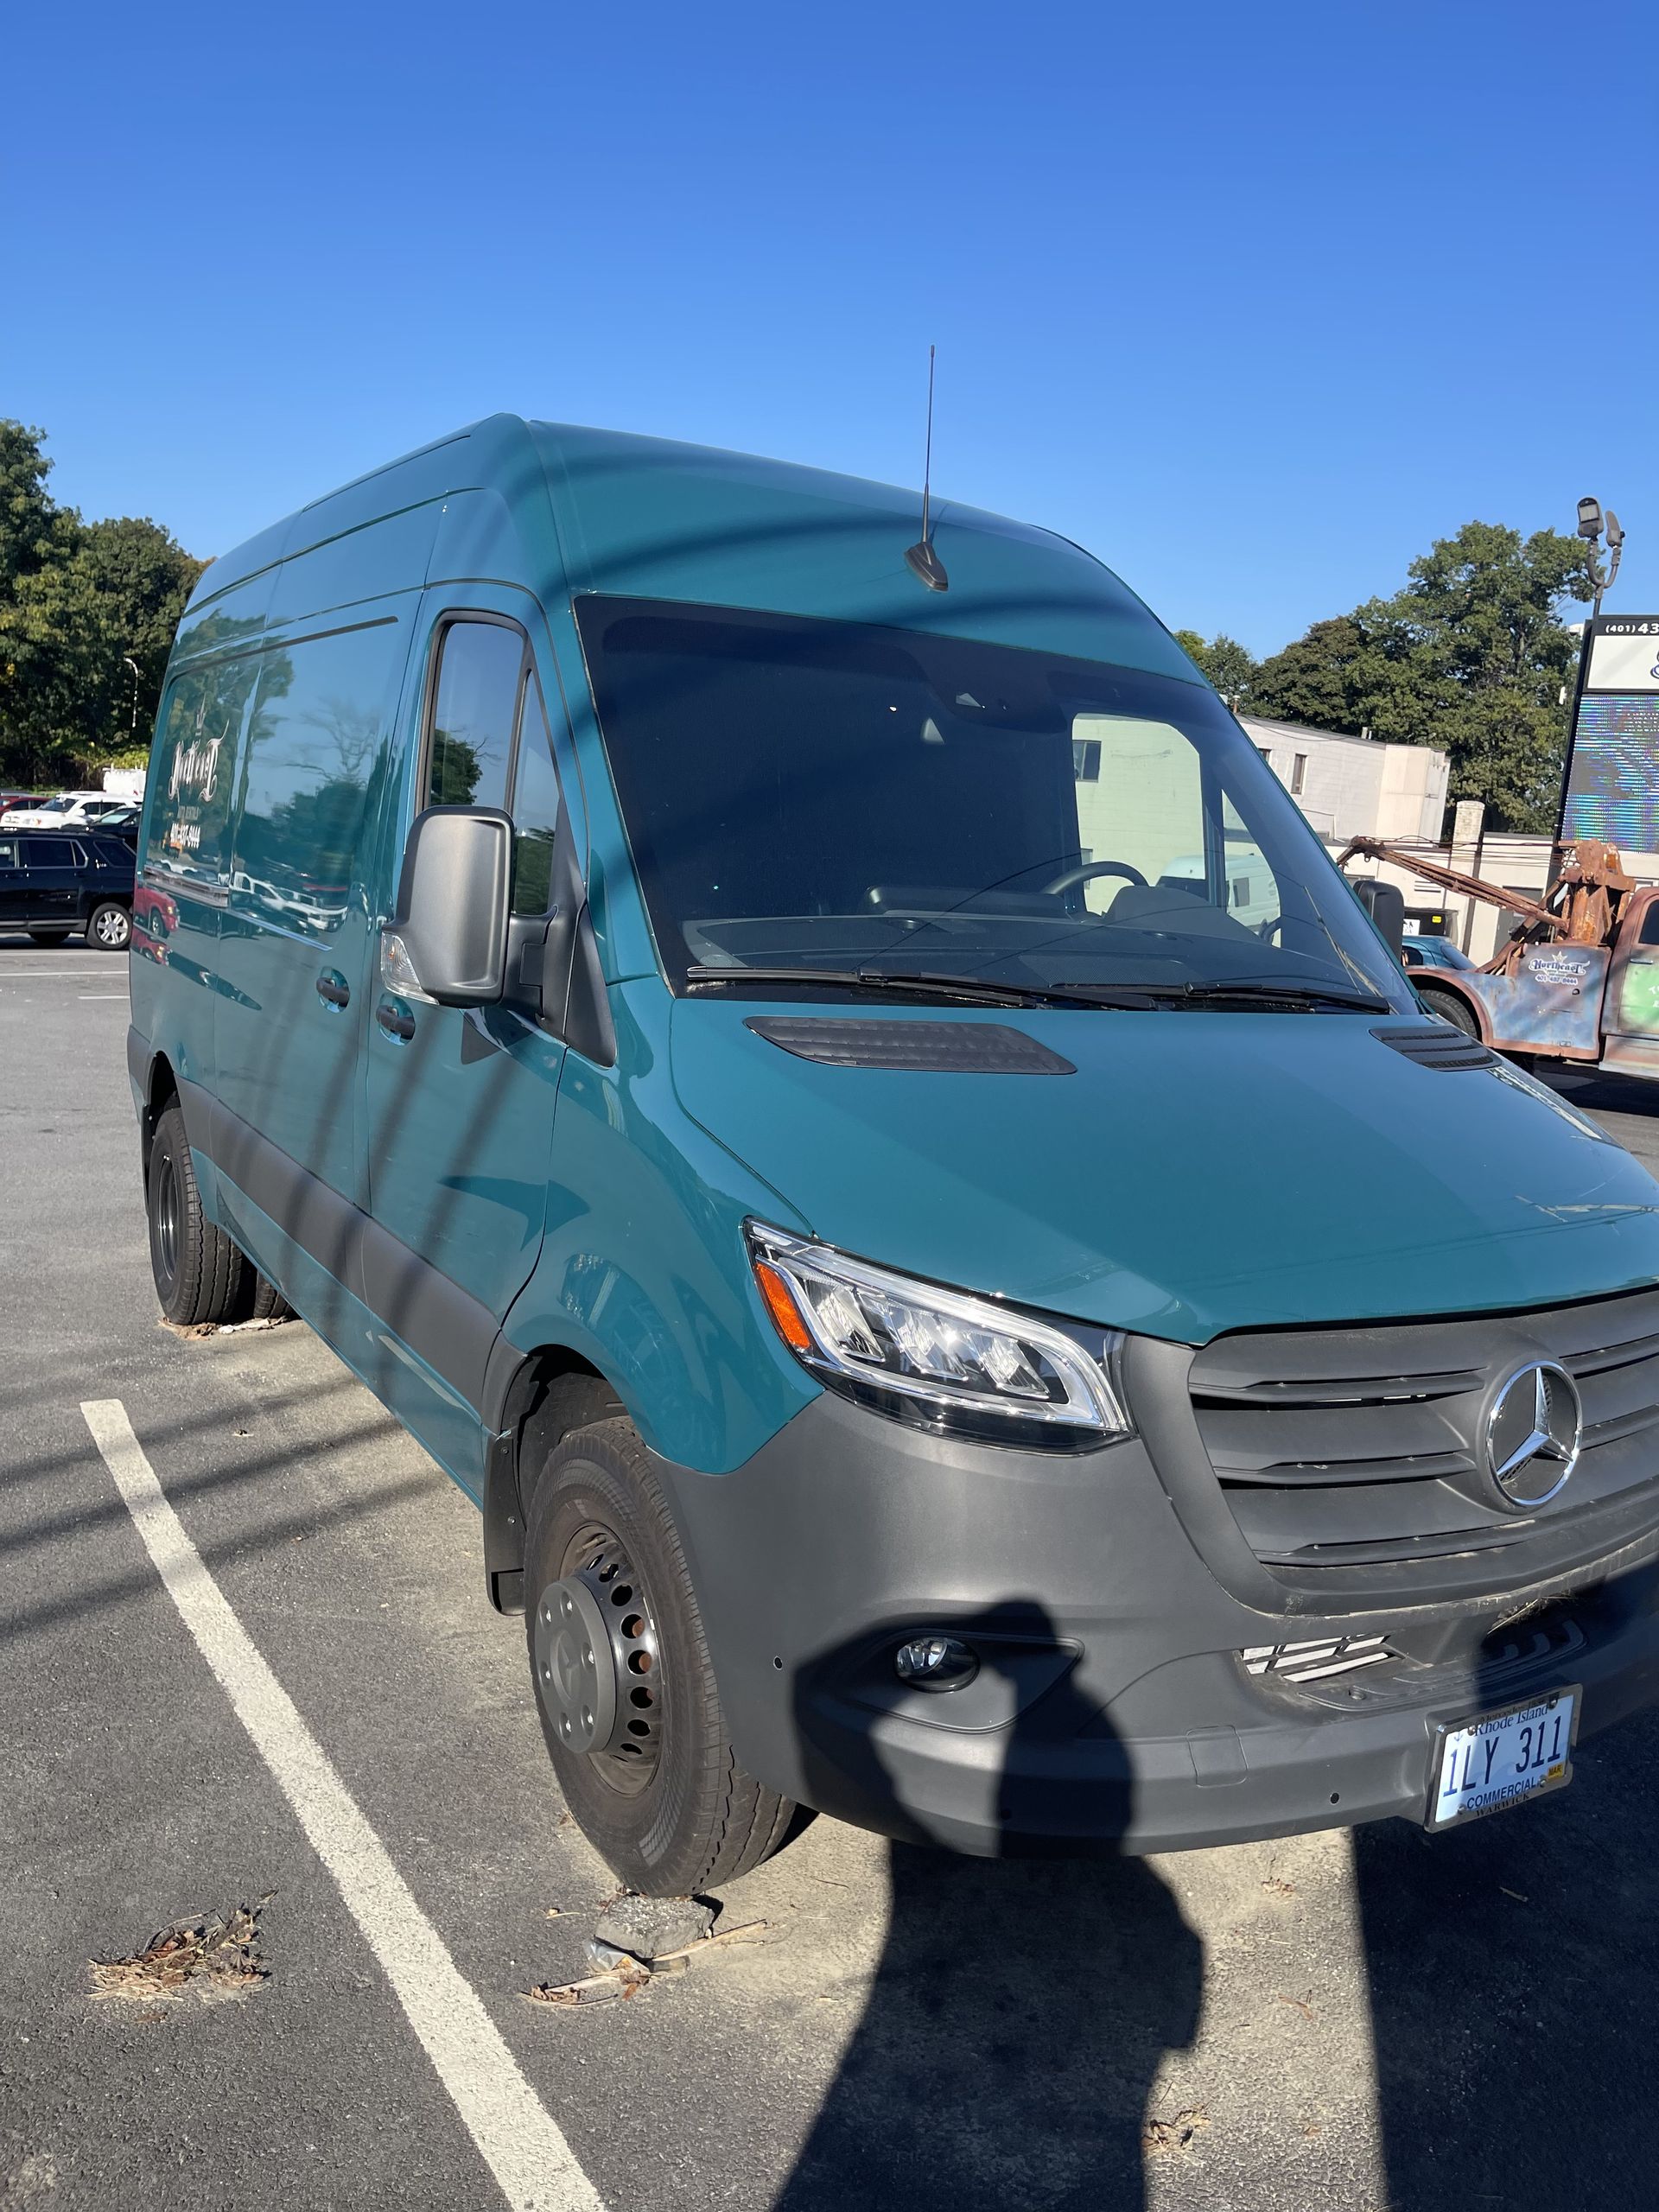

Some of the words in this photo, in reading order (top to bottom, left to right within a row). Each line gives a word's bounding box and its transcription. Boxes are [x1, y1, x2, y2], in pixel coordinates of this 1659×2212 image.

[1605, 625, 1636, 633] (401)
[1474, 1716, 1514, 1737] Rhode
[1516, 1703, 1548, 1725] Island
[1443, 1737, 1500, 1797] 1LY
[1516, 1715, 1561, 1774] 311
[1466, 1777, 1535, 1809] COMMERCIAL
[1477, 1794, 1530, 1817] WARWICK
